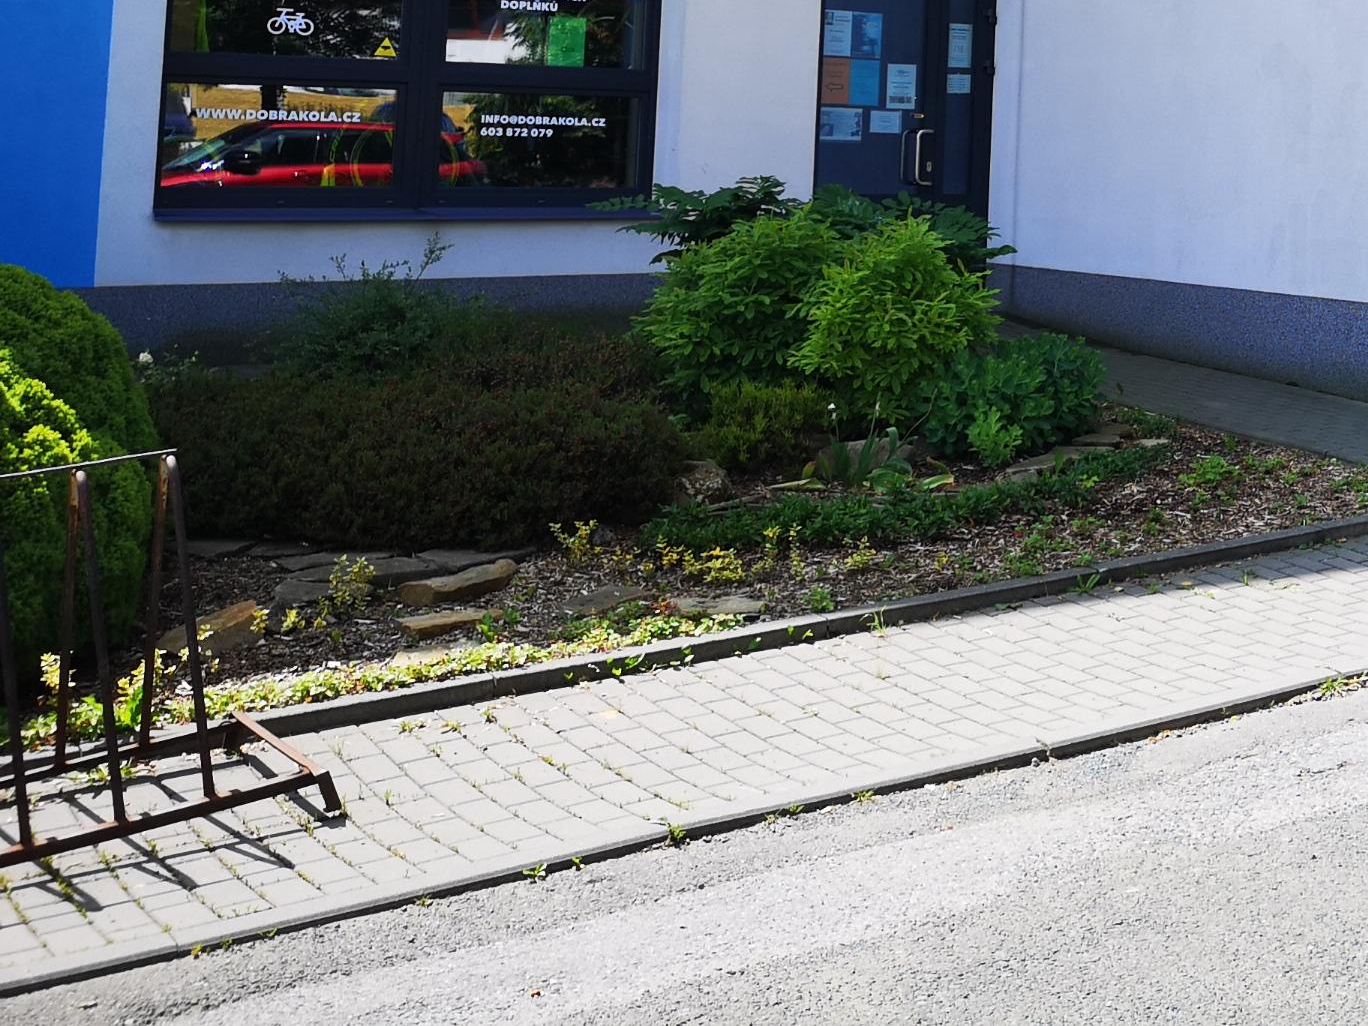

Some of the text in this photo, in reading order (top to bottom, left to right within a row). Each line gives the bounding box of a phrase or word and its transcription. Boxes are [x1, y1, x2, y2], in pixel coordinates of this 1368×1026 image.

[196, 108, 362, 123] WWW.DOBRAKOLA.CZ
[480, 114, 607, 127] INFO@DOBRAKOLA.CZ
[480, 127, 554, 138] 603 872 079
